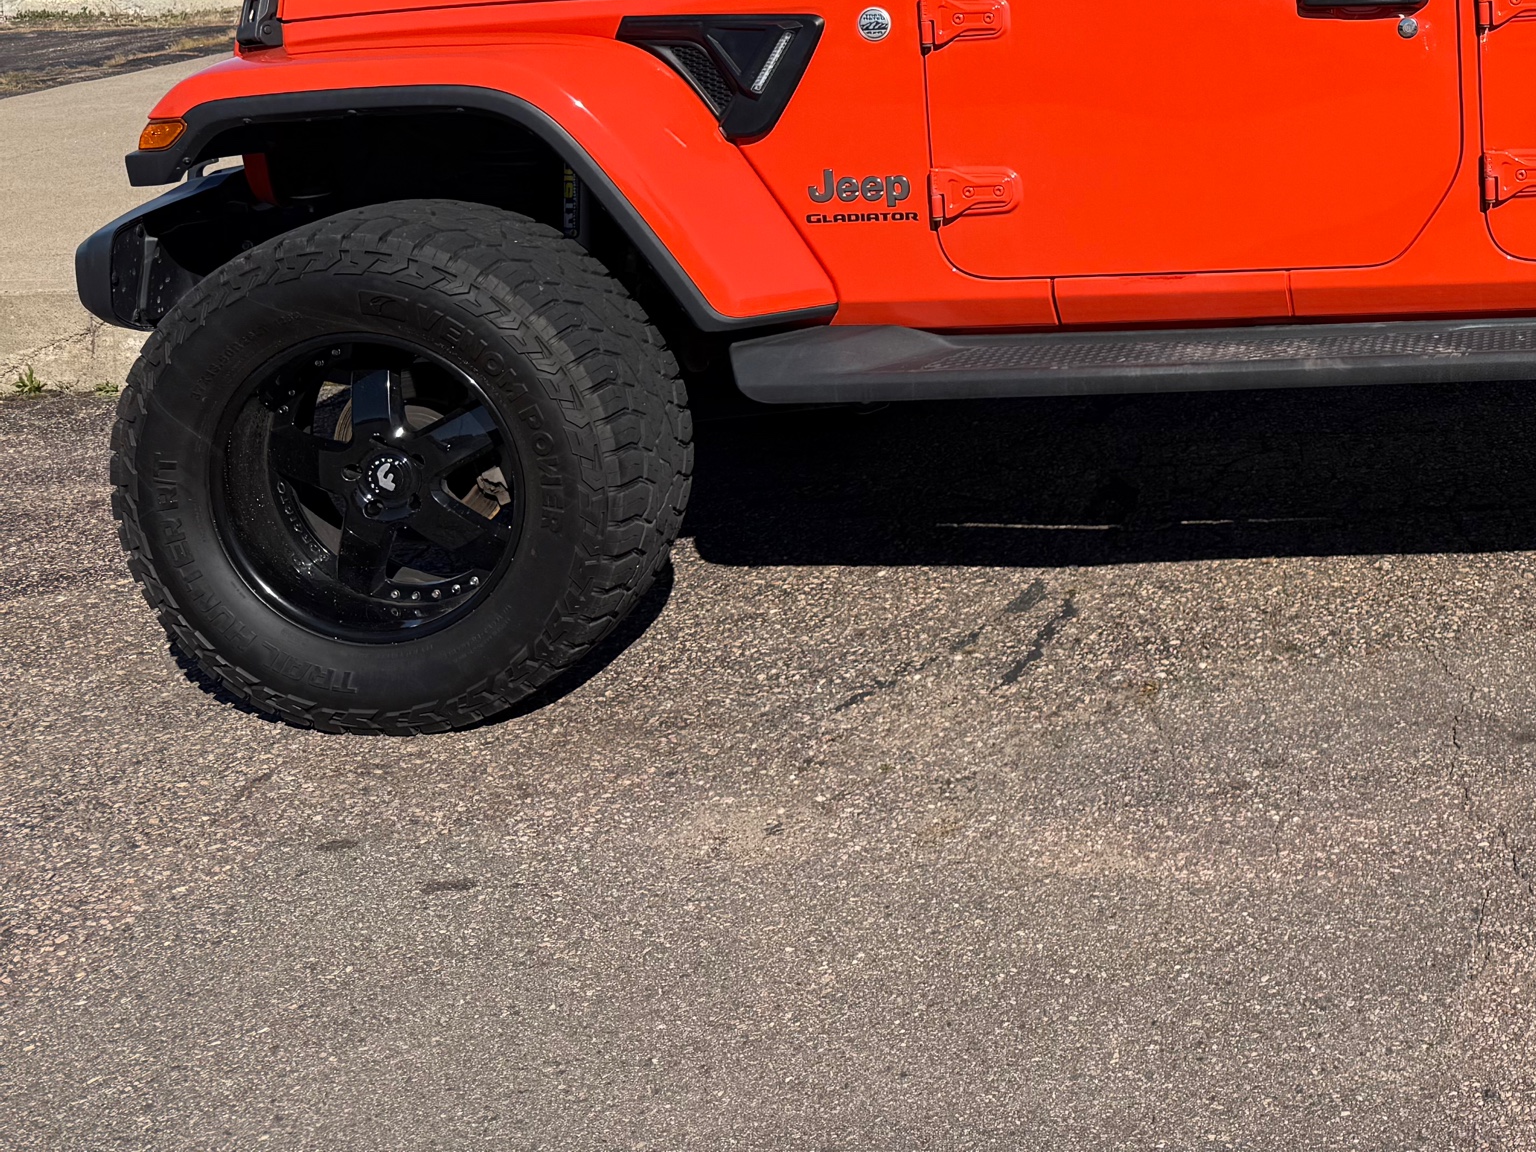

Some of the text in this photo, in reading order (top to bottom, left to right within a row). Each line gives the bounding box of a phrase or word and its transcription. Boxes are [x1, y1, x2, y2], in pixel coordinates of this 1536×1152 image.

[807, 168, 911, 207] Jeep
[806, 212, 919, 223] GLADIATOR
[409, 302, 530, 403] VENOM
[158, 517, 259, 654] HUNTER
[251, 639, 358, 693] TRAIL
